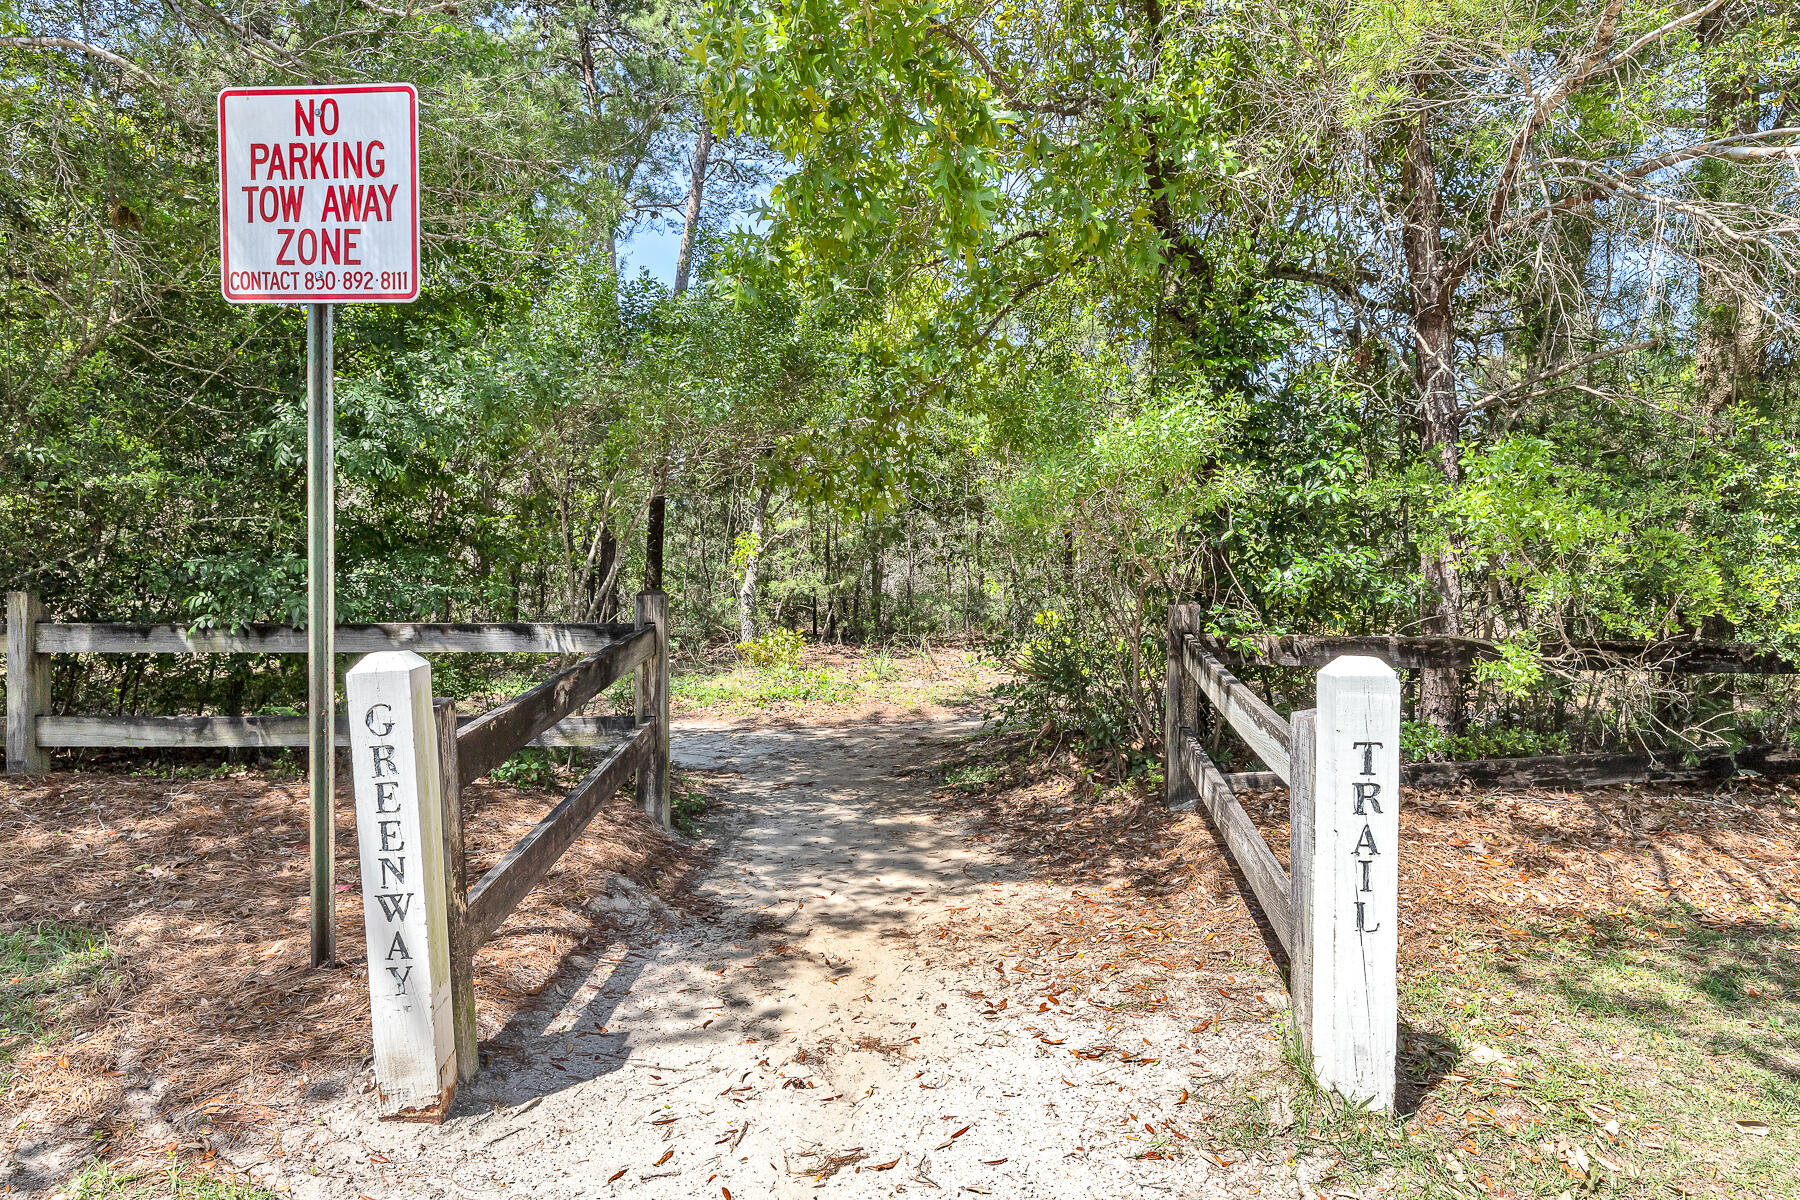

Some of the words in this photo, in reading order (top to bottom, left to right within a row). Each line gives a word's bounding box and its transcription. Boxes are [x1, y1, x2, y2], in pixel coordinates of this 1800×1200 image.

[295, 98, 339, 137] NO
[250, 140, 385, 181] PARKING
[241, 185, 304, 223] TOW
[320, 184, 399, 222] AWAY
[276, 228, 361, 266] ZONE
[230, 271, 300, 291] CONTACT
[365, 703, 415, 996] GREENWAY
[1351, 741, 1384, 933] TRAIL
